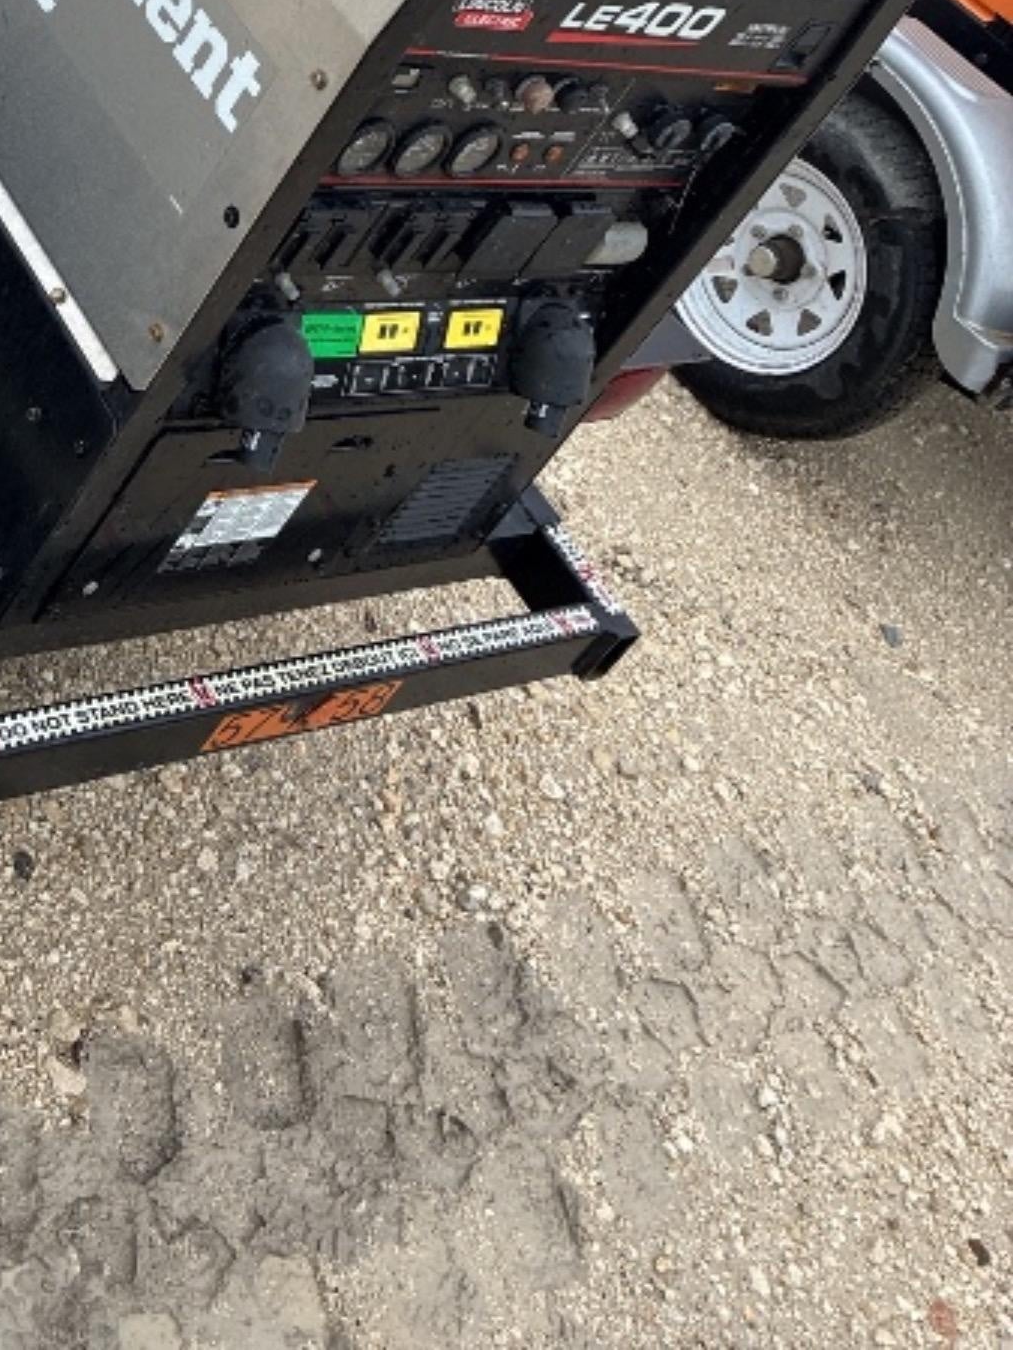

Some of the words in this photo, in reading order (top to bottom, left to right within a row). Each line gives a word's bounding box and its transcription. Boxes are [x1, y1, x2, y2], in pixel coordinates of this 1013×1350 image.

[559, 0, 727, 40] LE400
[31, 713, 72, 736] NOT
[74, 700, 140, 724] STAND
[139, 691, 189, 712] HERE
